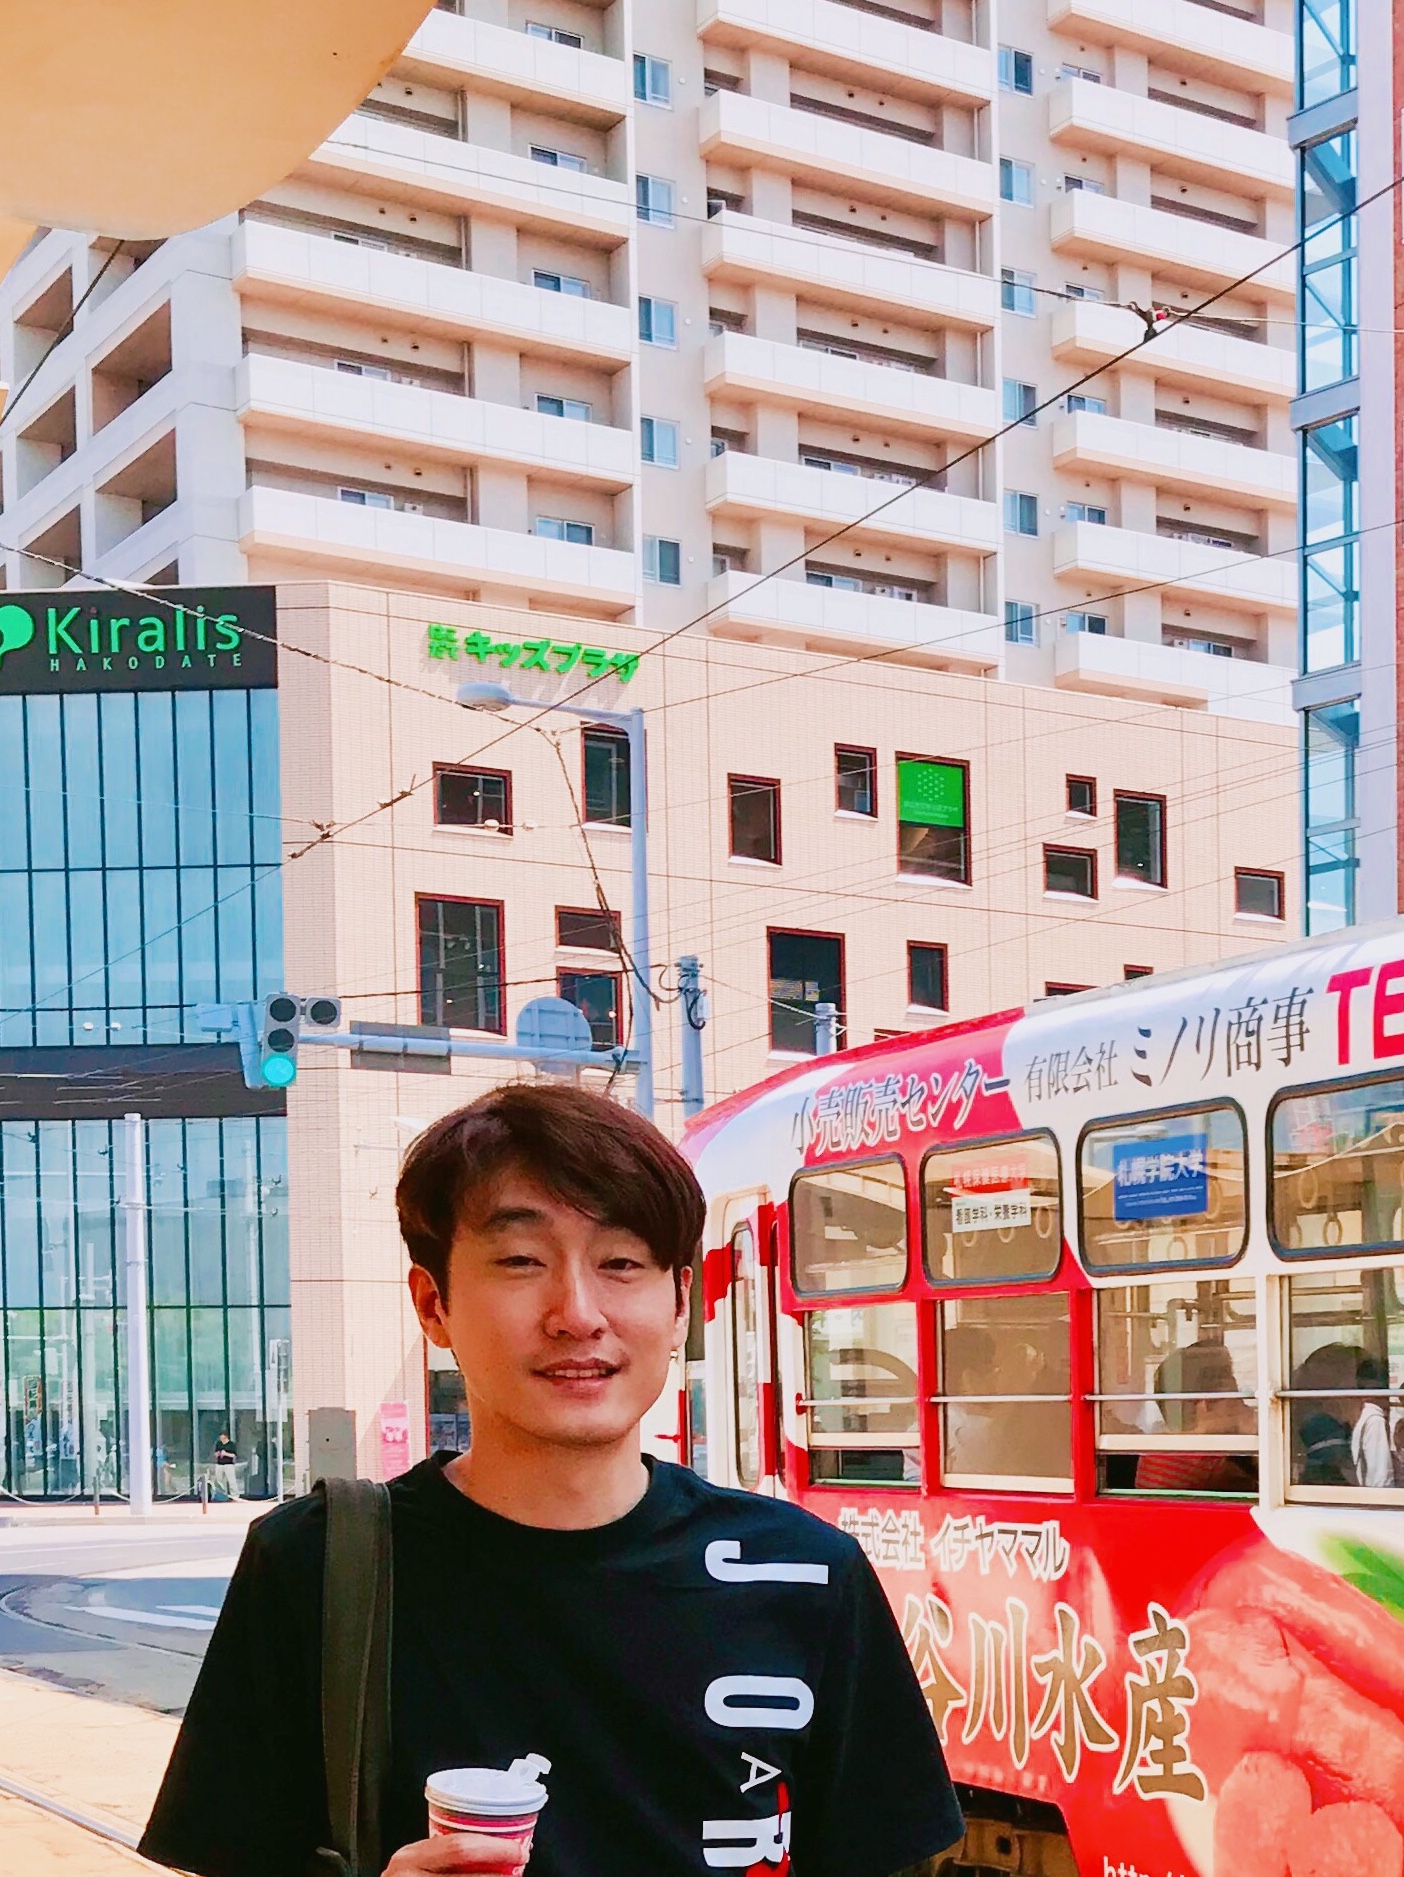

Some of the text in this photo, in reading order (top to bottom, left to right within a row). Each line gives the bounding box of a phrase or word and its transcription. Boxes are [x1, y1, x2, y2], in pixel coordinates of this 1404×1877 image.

[47, 604, 242, 655] Kiralis
[50, 653, 242, 672] HAKODATE
[465, 630, 641, 683] キッズプラザ
[790, 1058, 1011, 1158] 小売販売センター
[1024, 1040, 1119, 1104] 有限会社
[1130, 986, 1316, 1088] ミノリ商事
[839, 1506, 1071, 1583] 株式会社 イチヤママル
